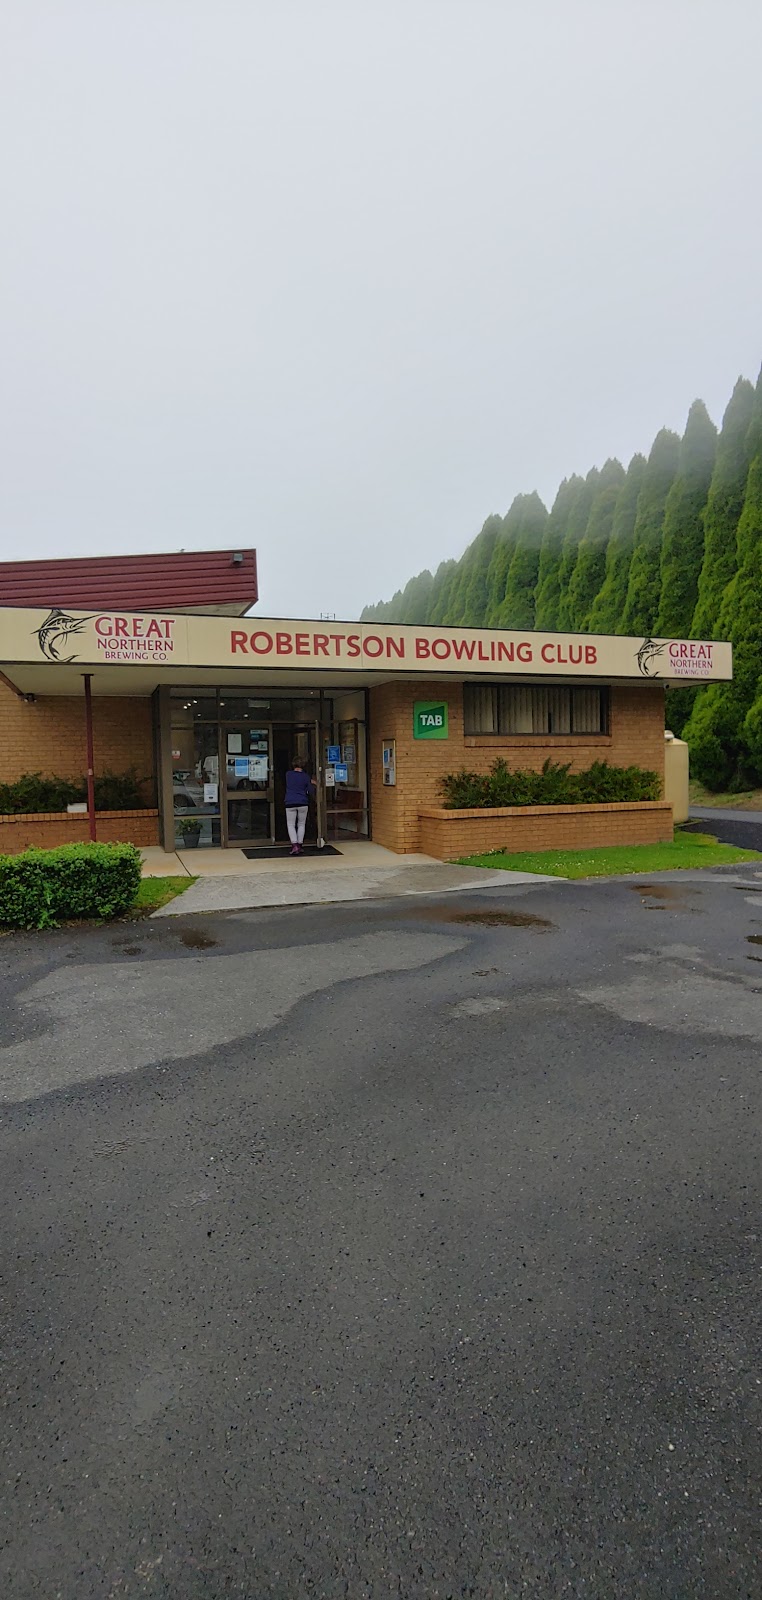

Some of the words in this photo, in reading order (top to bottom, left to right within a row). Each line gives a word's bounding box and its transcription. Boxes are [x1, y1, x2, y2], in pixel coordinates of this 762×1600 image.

[95, 616, 175, 638] GREAT
[97, 638, 173, 651] NORTHERN
[231, 631, 405, 658] ROBERTSON
[415, 637, 532, 662] BOWLING
[541, 643, 597, 664] CLUB
[669, 643, 713, 659] GREAT
[105, 651, 149, 660] BREWING
[152, 652, 169, 661] CO.
[670, 659, 713, 669] NORTHERN
[420, 715, 443, 726] TAB
